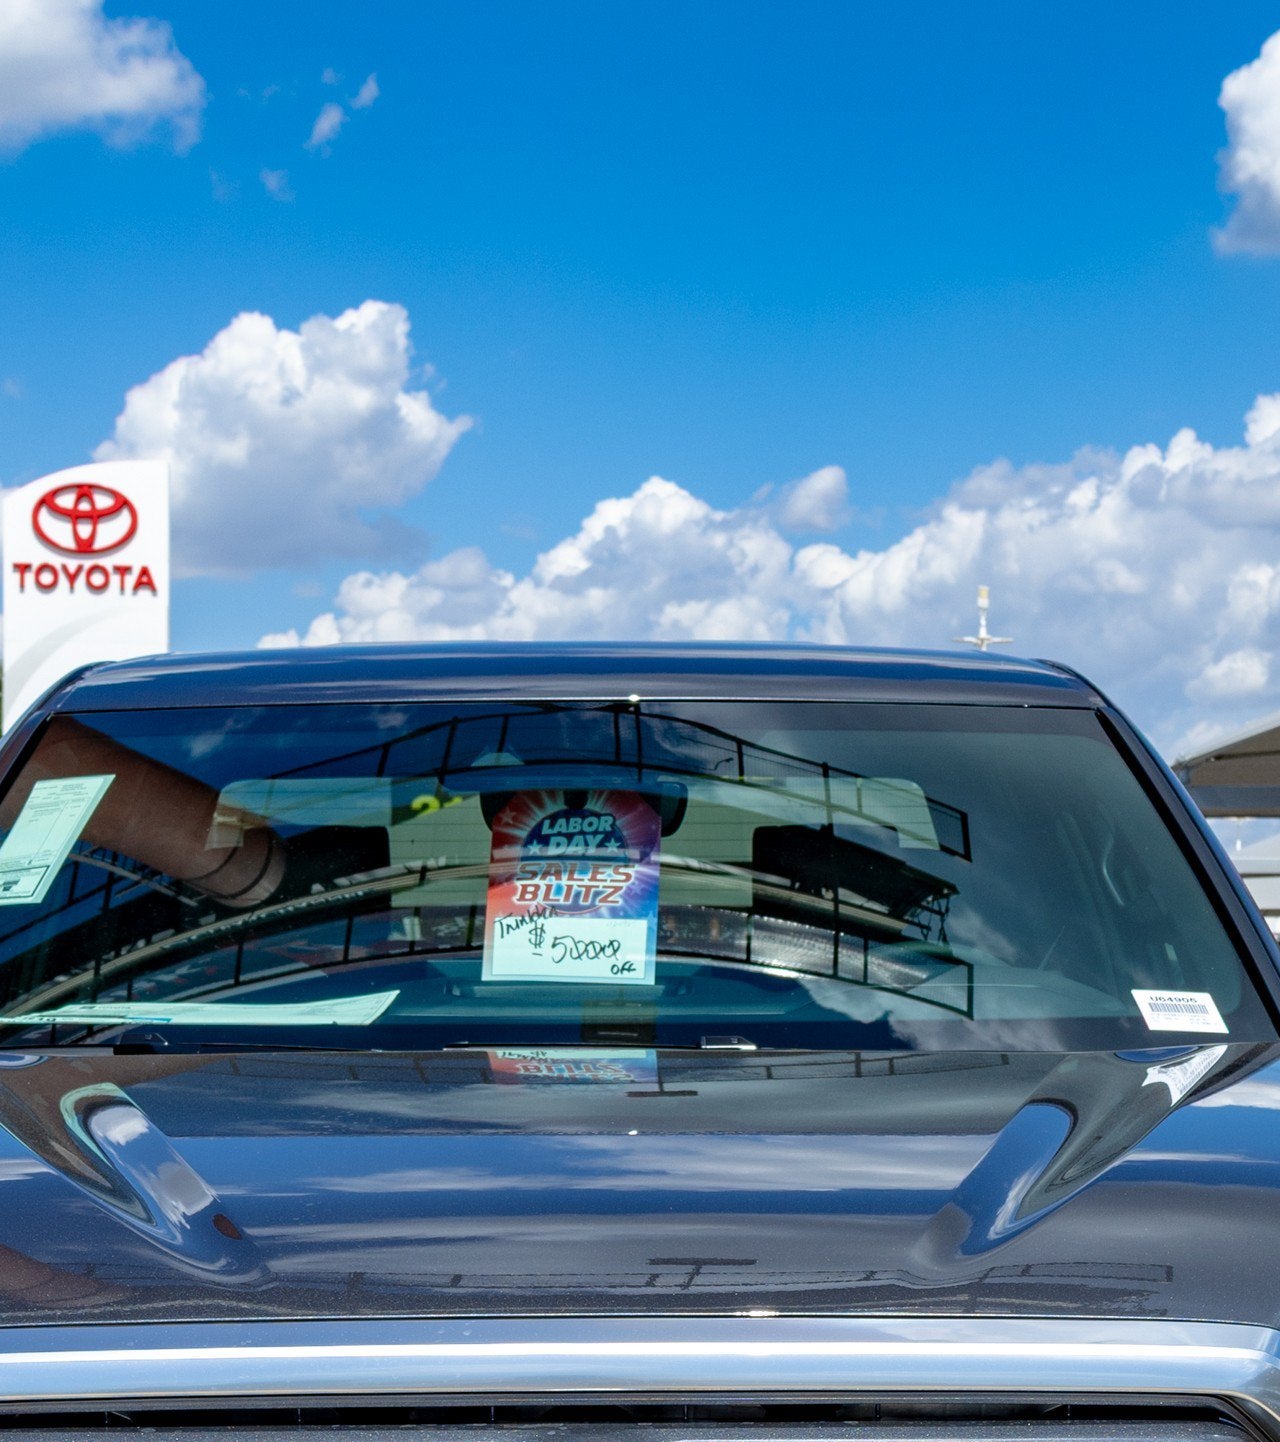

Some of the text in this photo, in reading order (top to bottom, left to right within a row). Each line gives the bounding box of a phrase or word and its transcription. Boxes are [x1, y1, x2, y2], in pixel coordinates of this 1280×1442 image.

[13, 563, 157, 596] TOYOTA
[542, 816, 614, 835] LABOR
[547, 834, 604, 855] DAY
[516, 862, 635, 883] SALES
[517, 884, 624, 904] BLITZ
